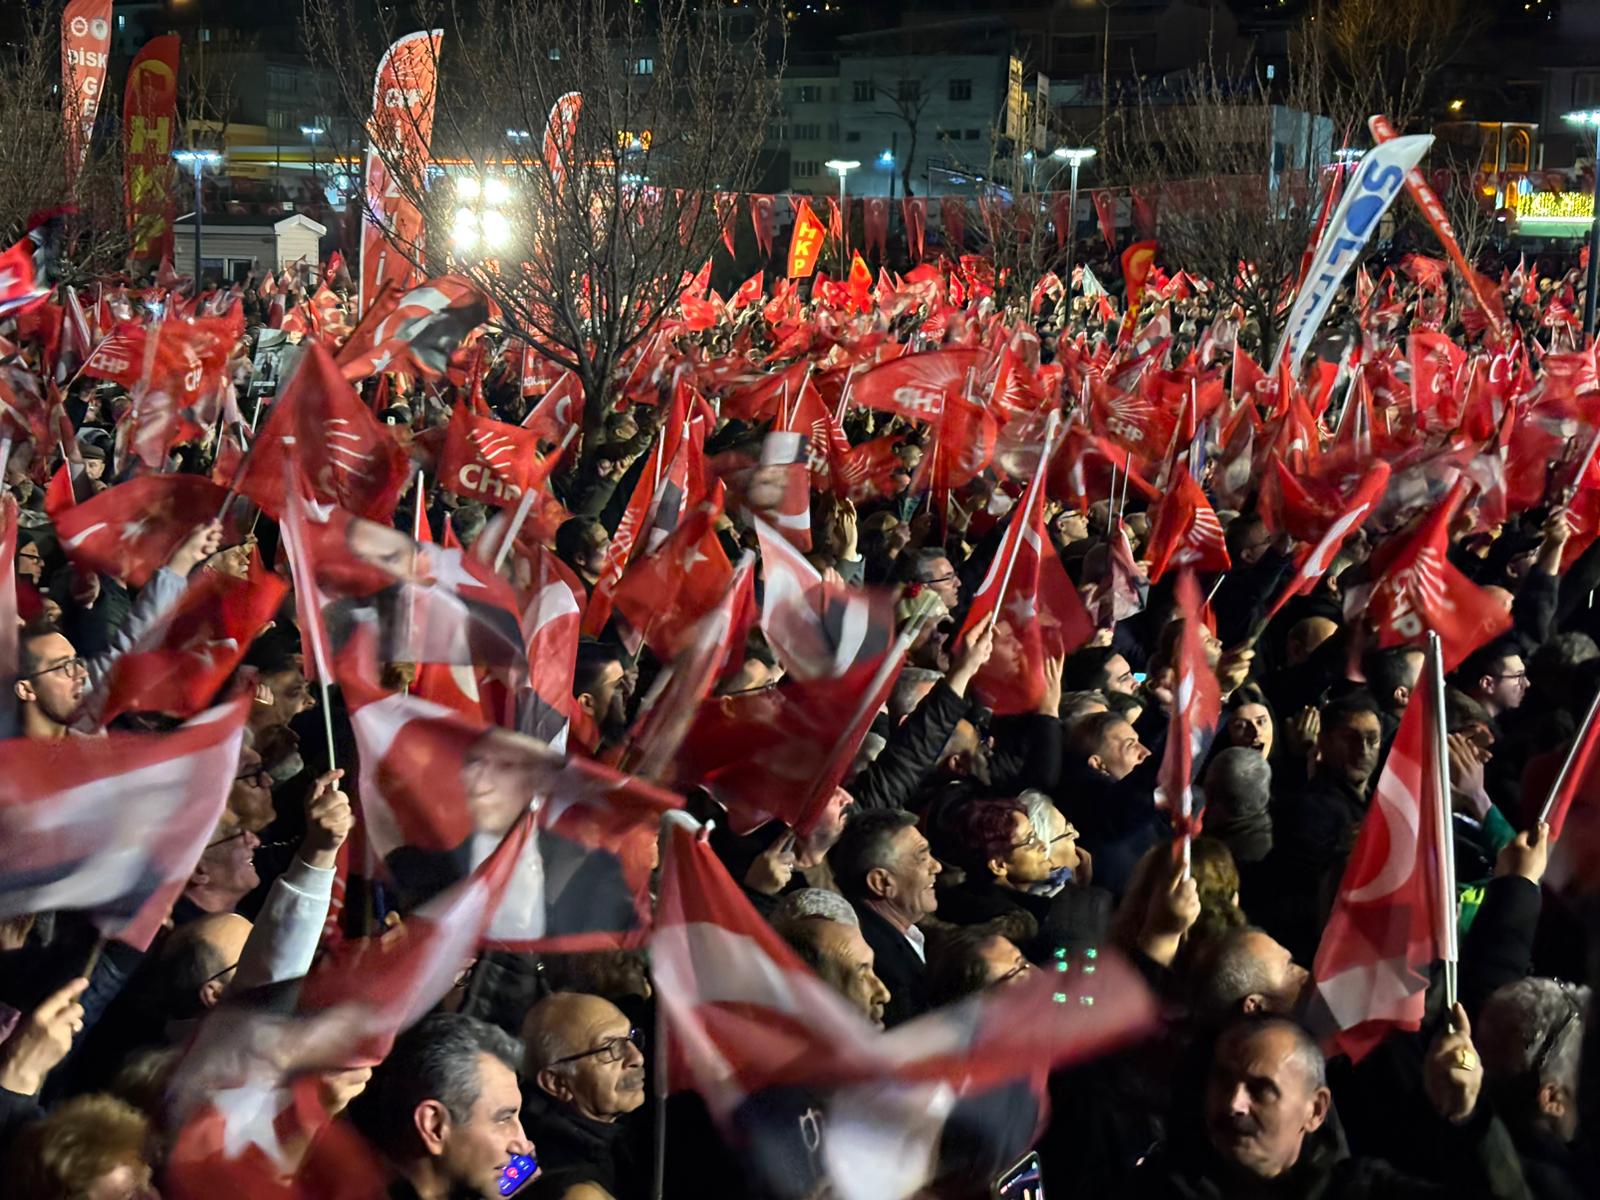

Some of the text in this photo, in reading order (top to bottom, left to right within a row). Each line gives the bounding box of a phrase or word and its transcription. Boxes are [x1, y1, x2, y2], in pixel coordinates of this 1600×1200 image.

[794, 222, 817, 275] HKP
[90, 353, 130, 374] CHP
[1255, 379, 1279, 395] CH
[1106, 416, 1144, 441] CHP
[459, 463, 522, 501] CHP
